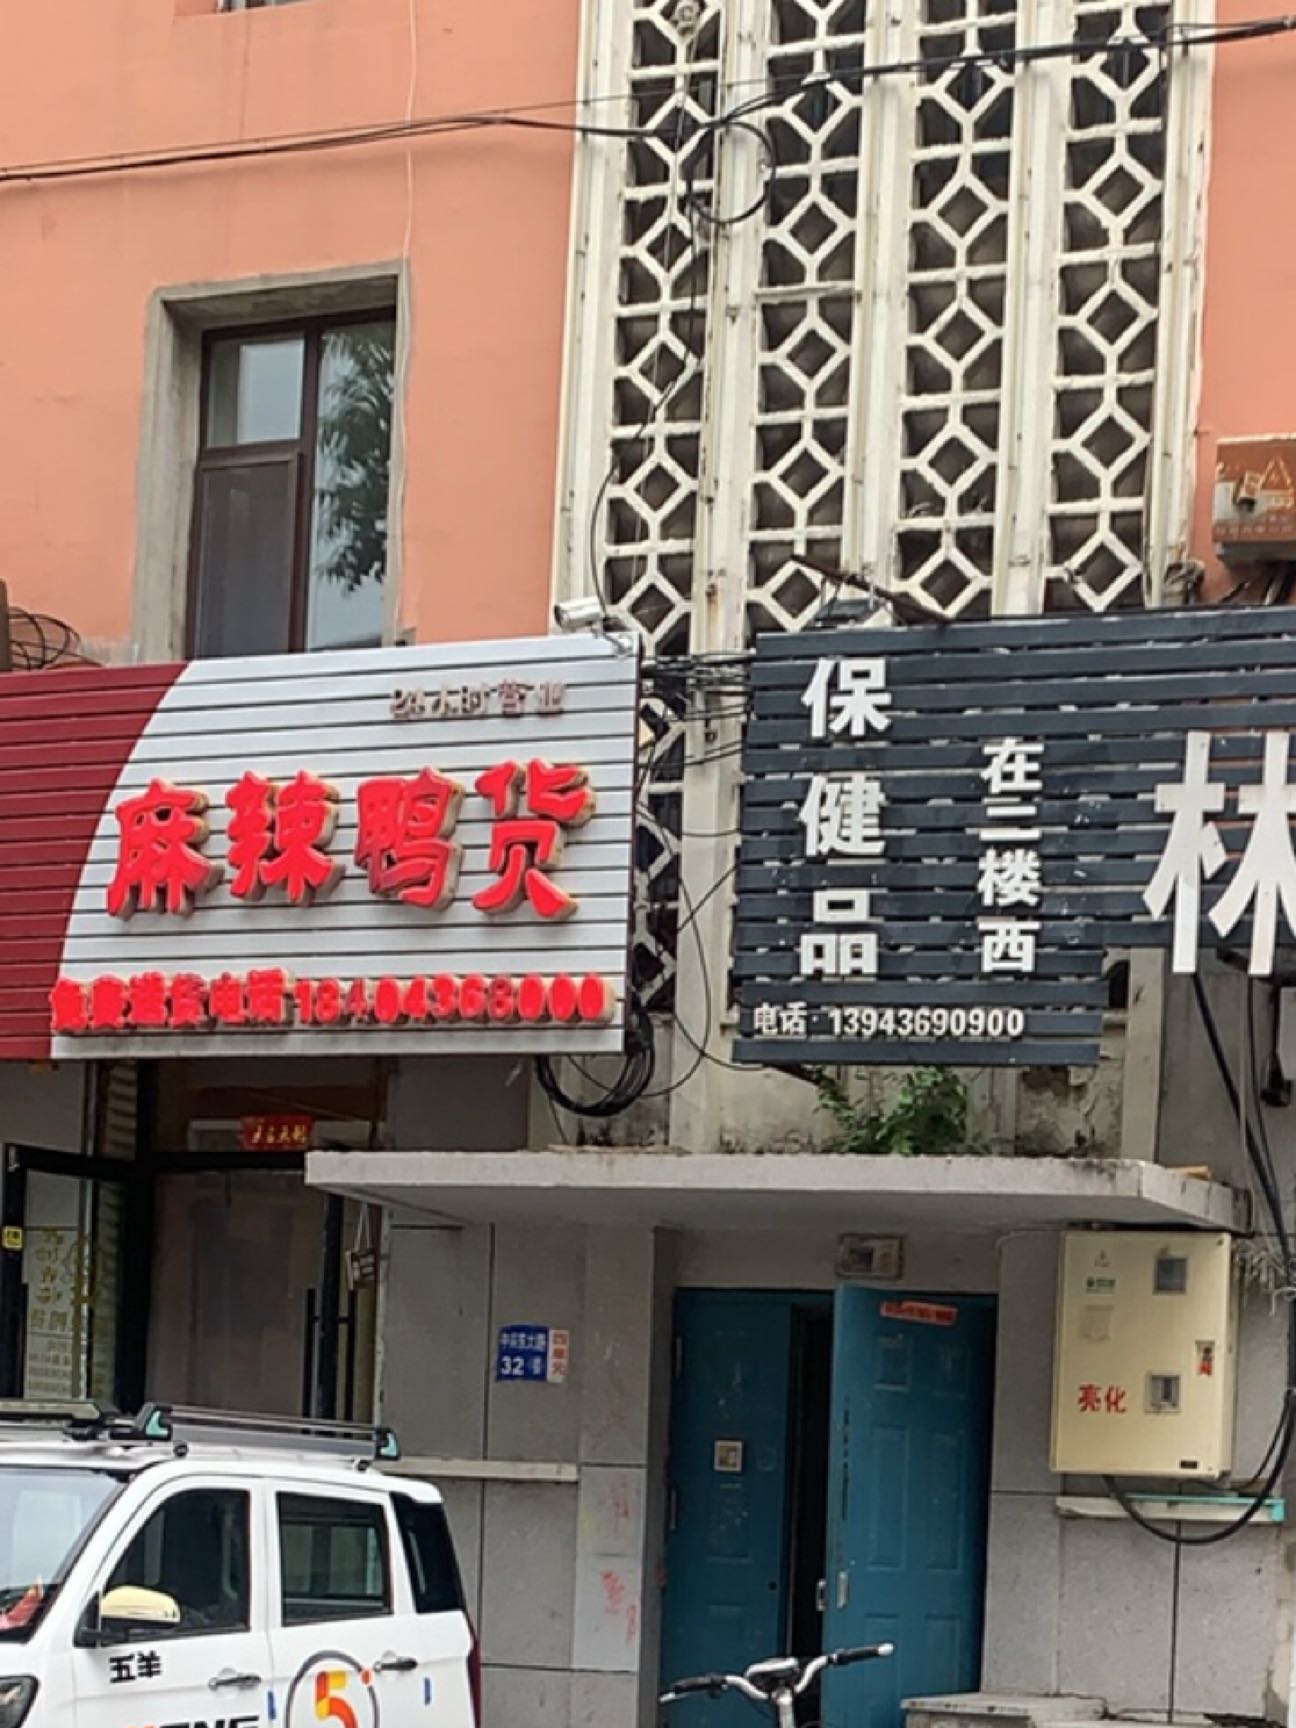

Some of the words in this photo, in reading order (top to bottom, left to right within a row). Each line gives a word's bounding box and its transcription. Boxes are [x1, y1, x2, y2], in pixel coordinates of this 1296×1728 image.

[106, 757, 597, 919] 麻辣鸭货
[799, 657, 892, 975] 保健品
[1077, 1383, 1128, 1414] 亮化
[108, 1650, 162, 1684] 五羊
